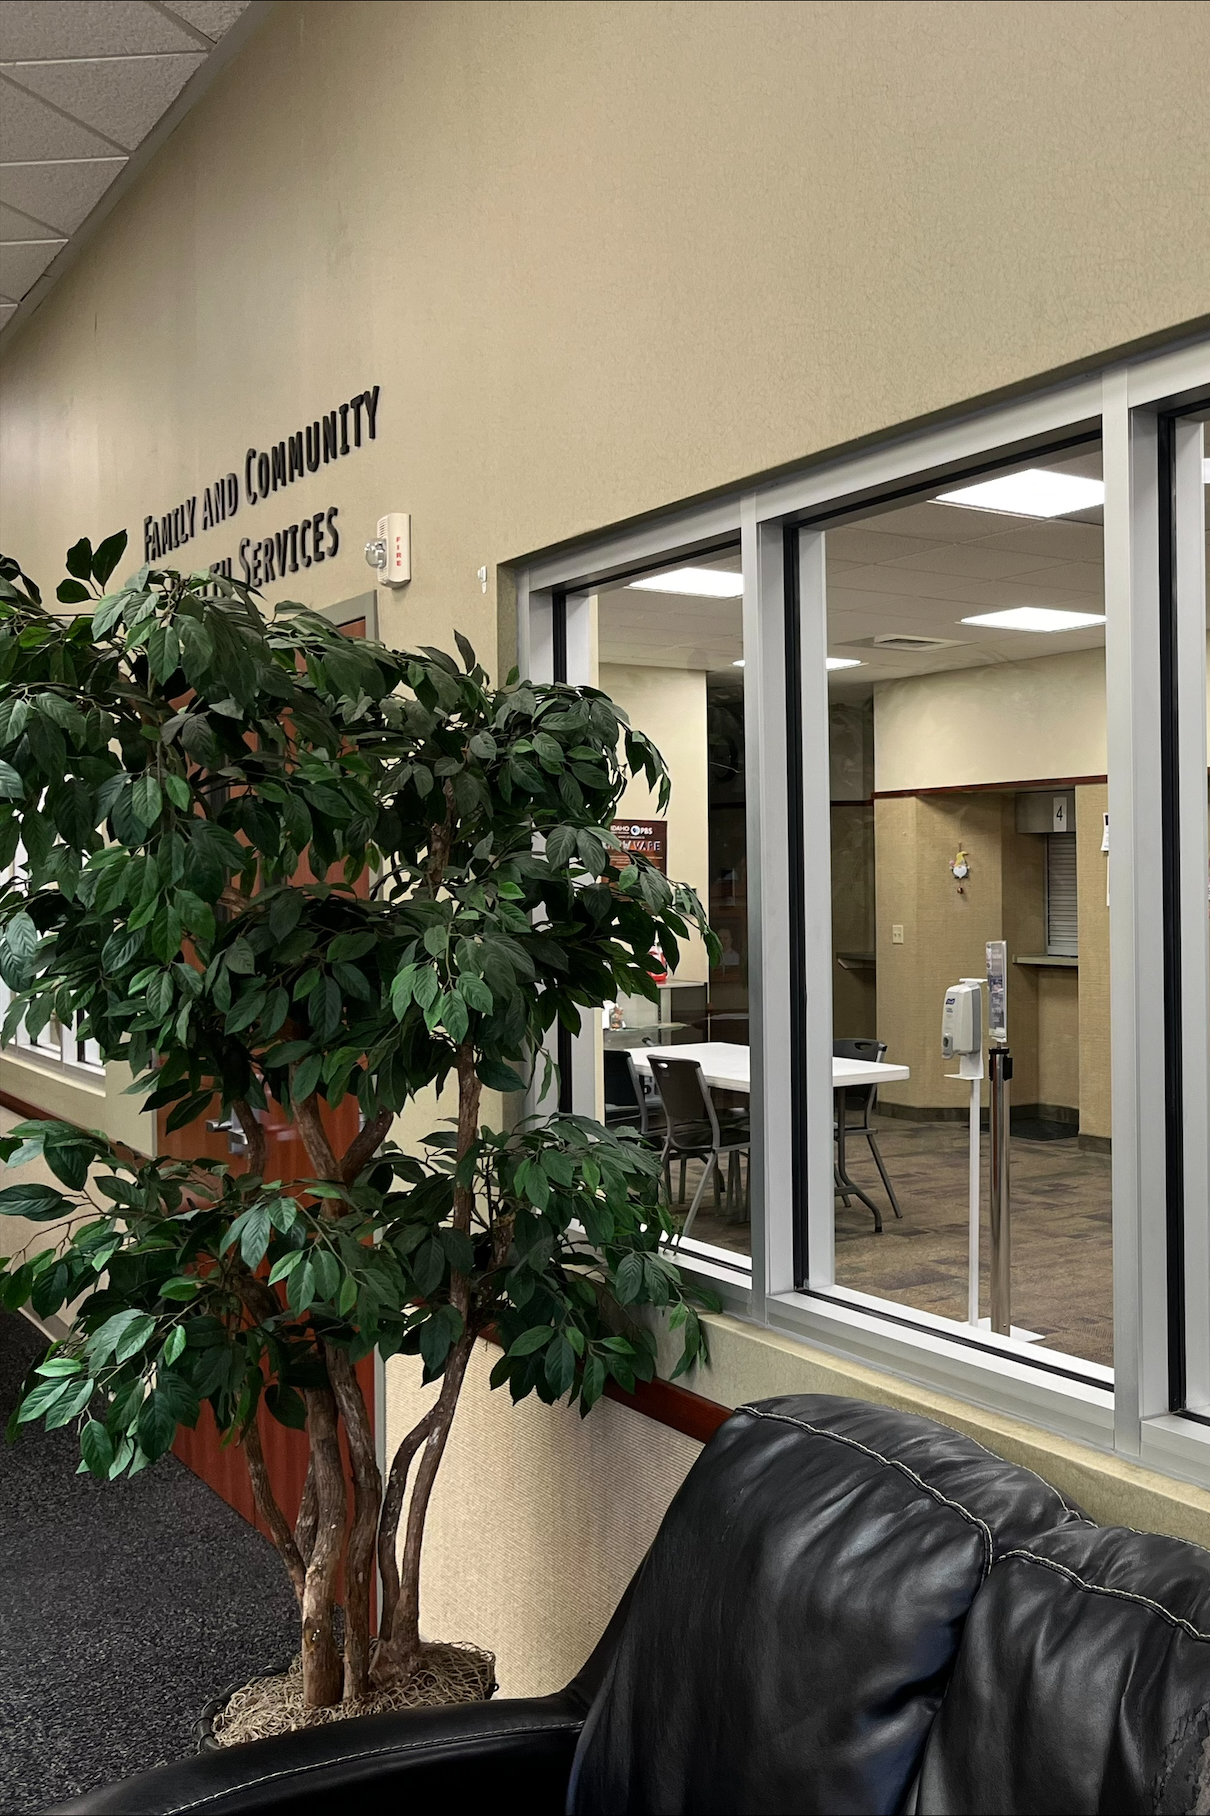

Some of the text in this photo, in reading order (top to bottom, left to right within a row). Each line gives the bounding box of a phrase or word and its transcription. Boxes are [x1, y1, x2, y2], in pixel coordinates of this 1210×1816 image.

[143, 385, 380, 562] FAMILY AND COMMUNITY
[238, 506, 339, 588] SERVICES
[640, 827, 653, 835] PBS
[1056, 805, 1063, 821] 4
